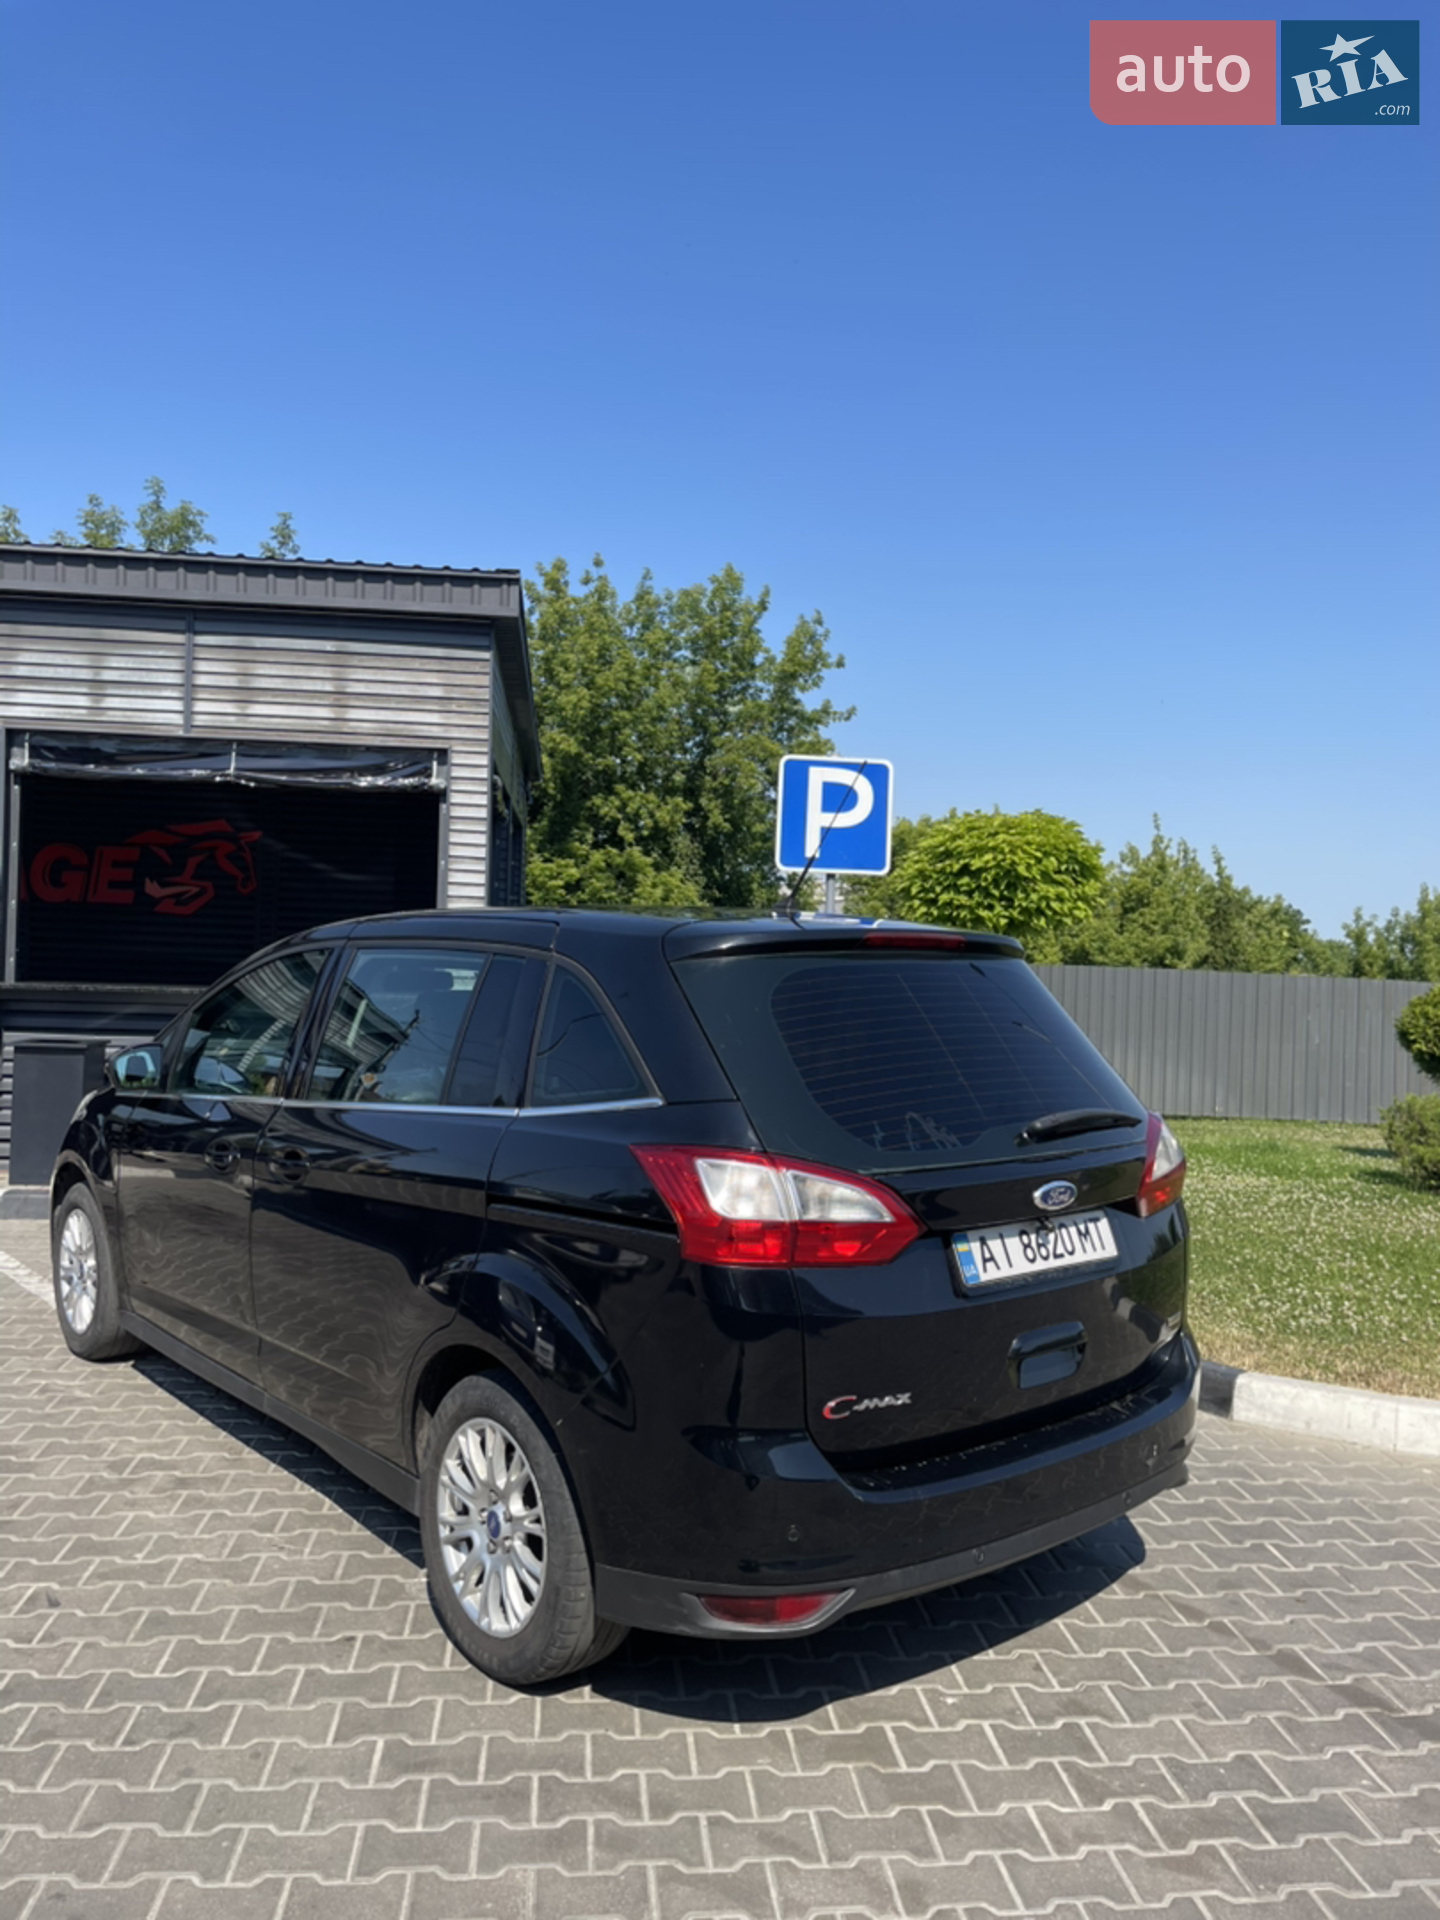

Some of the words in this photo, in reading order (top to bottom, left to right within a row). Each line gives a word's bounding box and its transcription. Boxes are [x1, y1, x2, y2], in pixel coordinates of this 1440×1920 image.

[804, 766, 874, 858] P
[979, 1232, 1014, 1273] AI
[1019, 1223, 1075, 1264] 8620
[1075, 1217, 1106, 1255] MT
